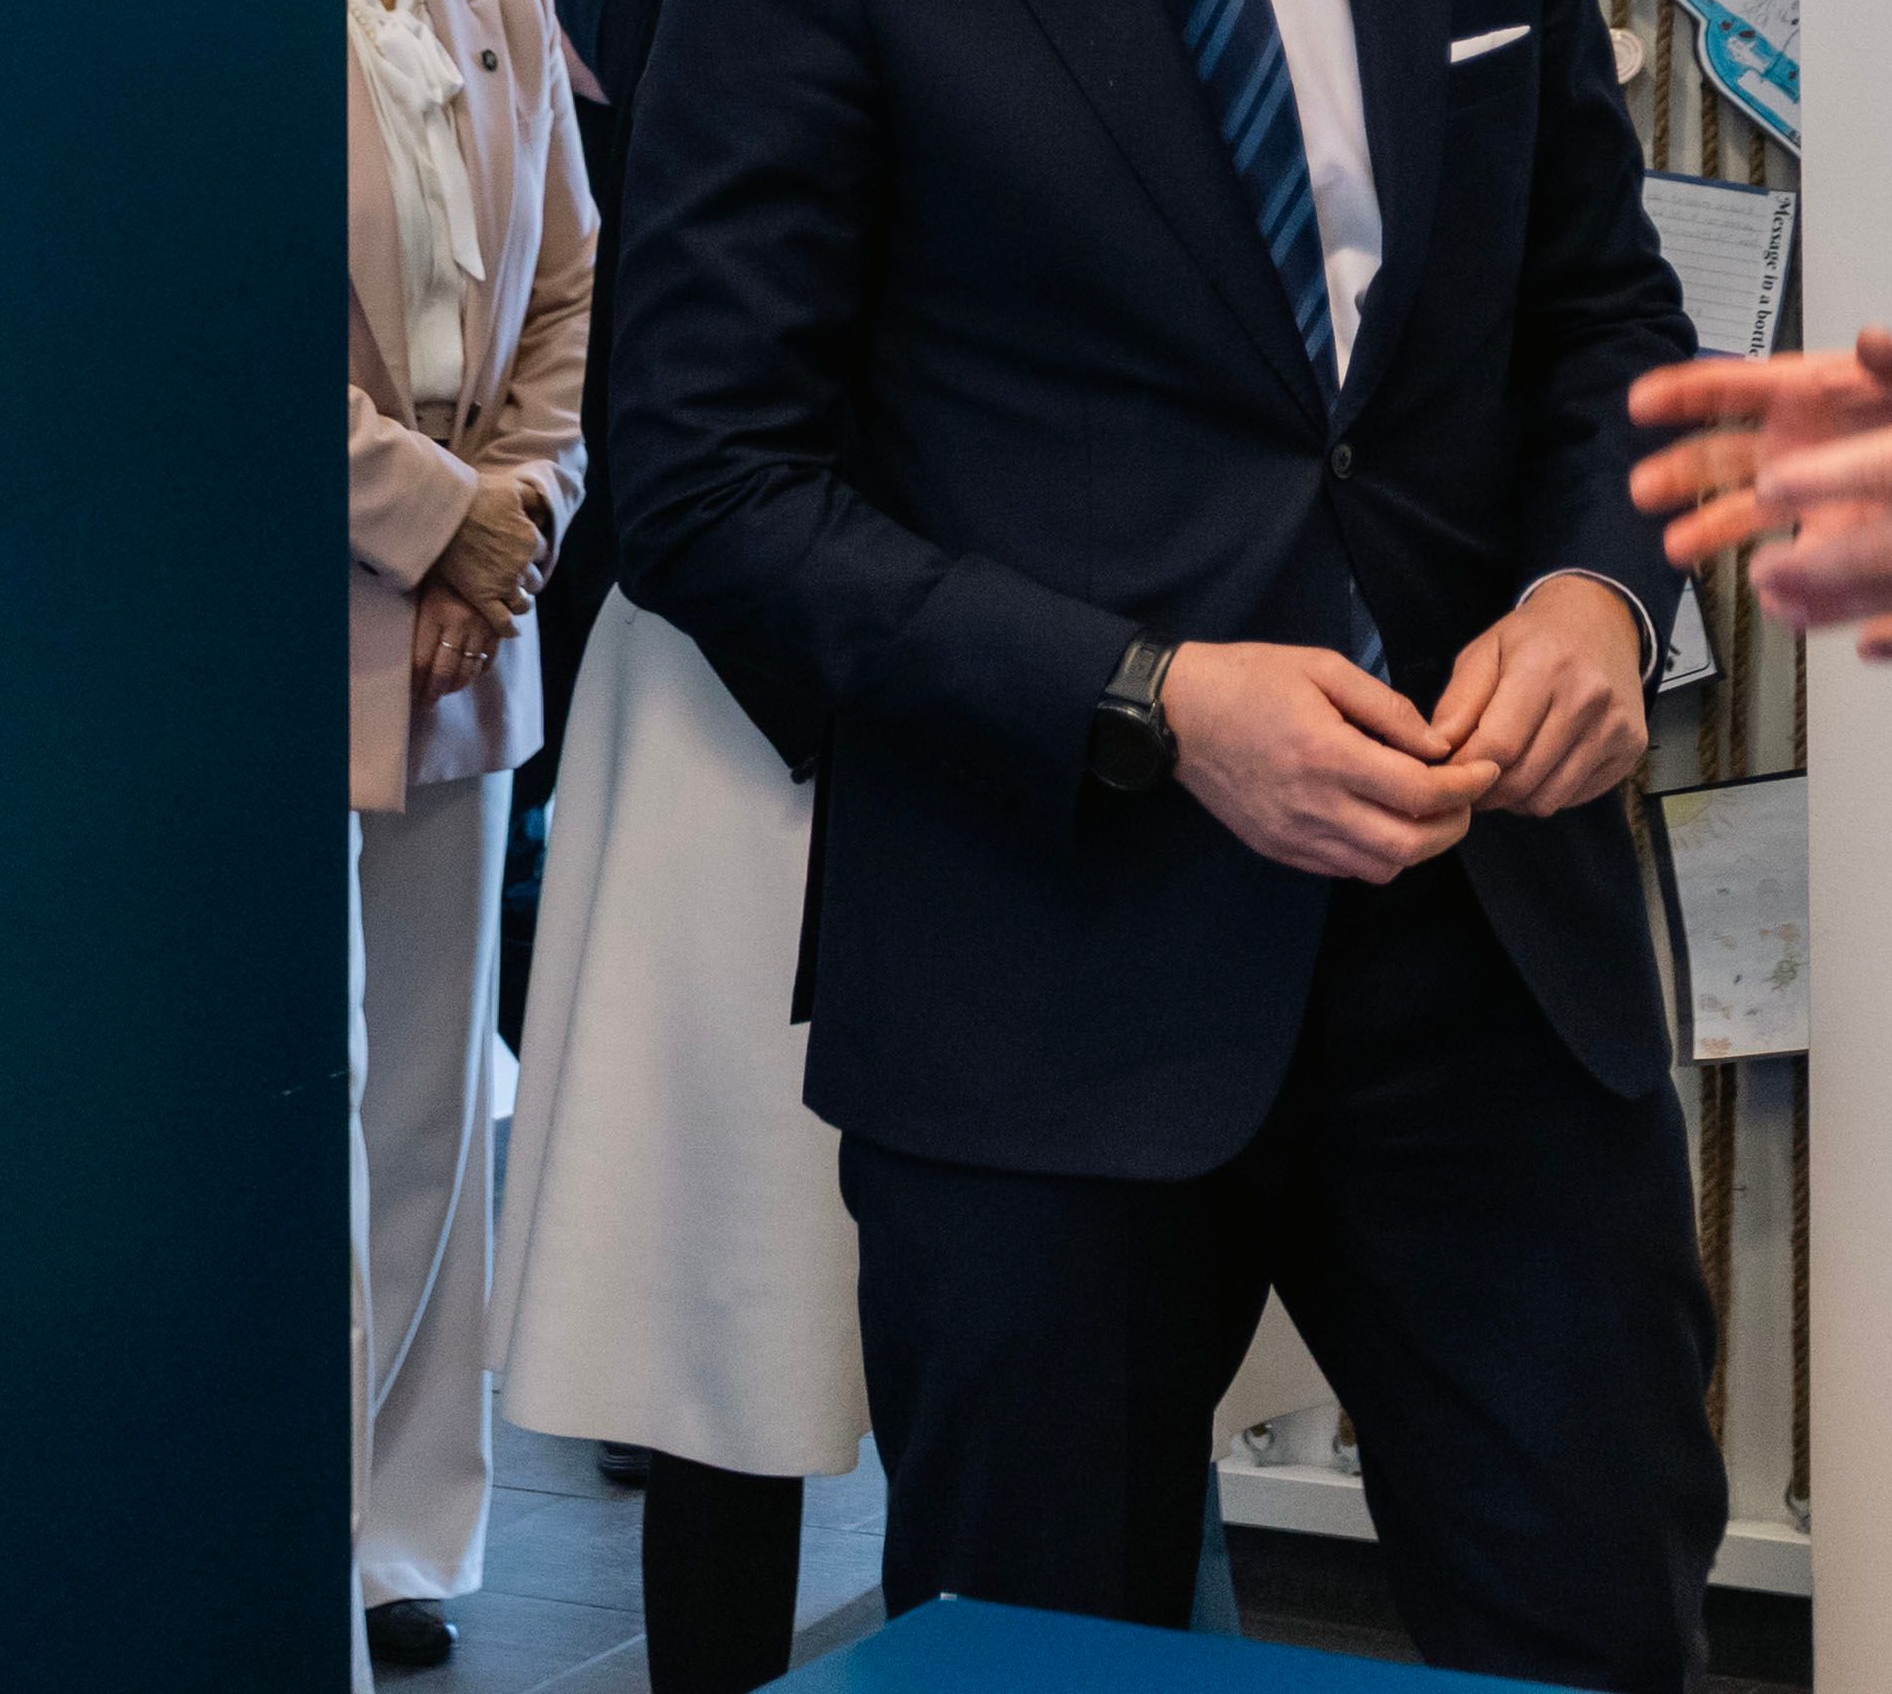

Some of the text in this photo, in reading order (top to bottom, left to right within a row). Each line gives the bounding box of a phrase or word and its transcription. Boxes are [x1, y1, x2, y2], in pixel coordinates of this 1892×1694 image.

[1763, 196, 1793, 271] Message
[1758, 294, 1772, 305] a
[1749, 309, 1773, 358] bottle
